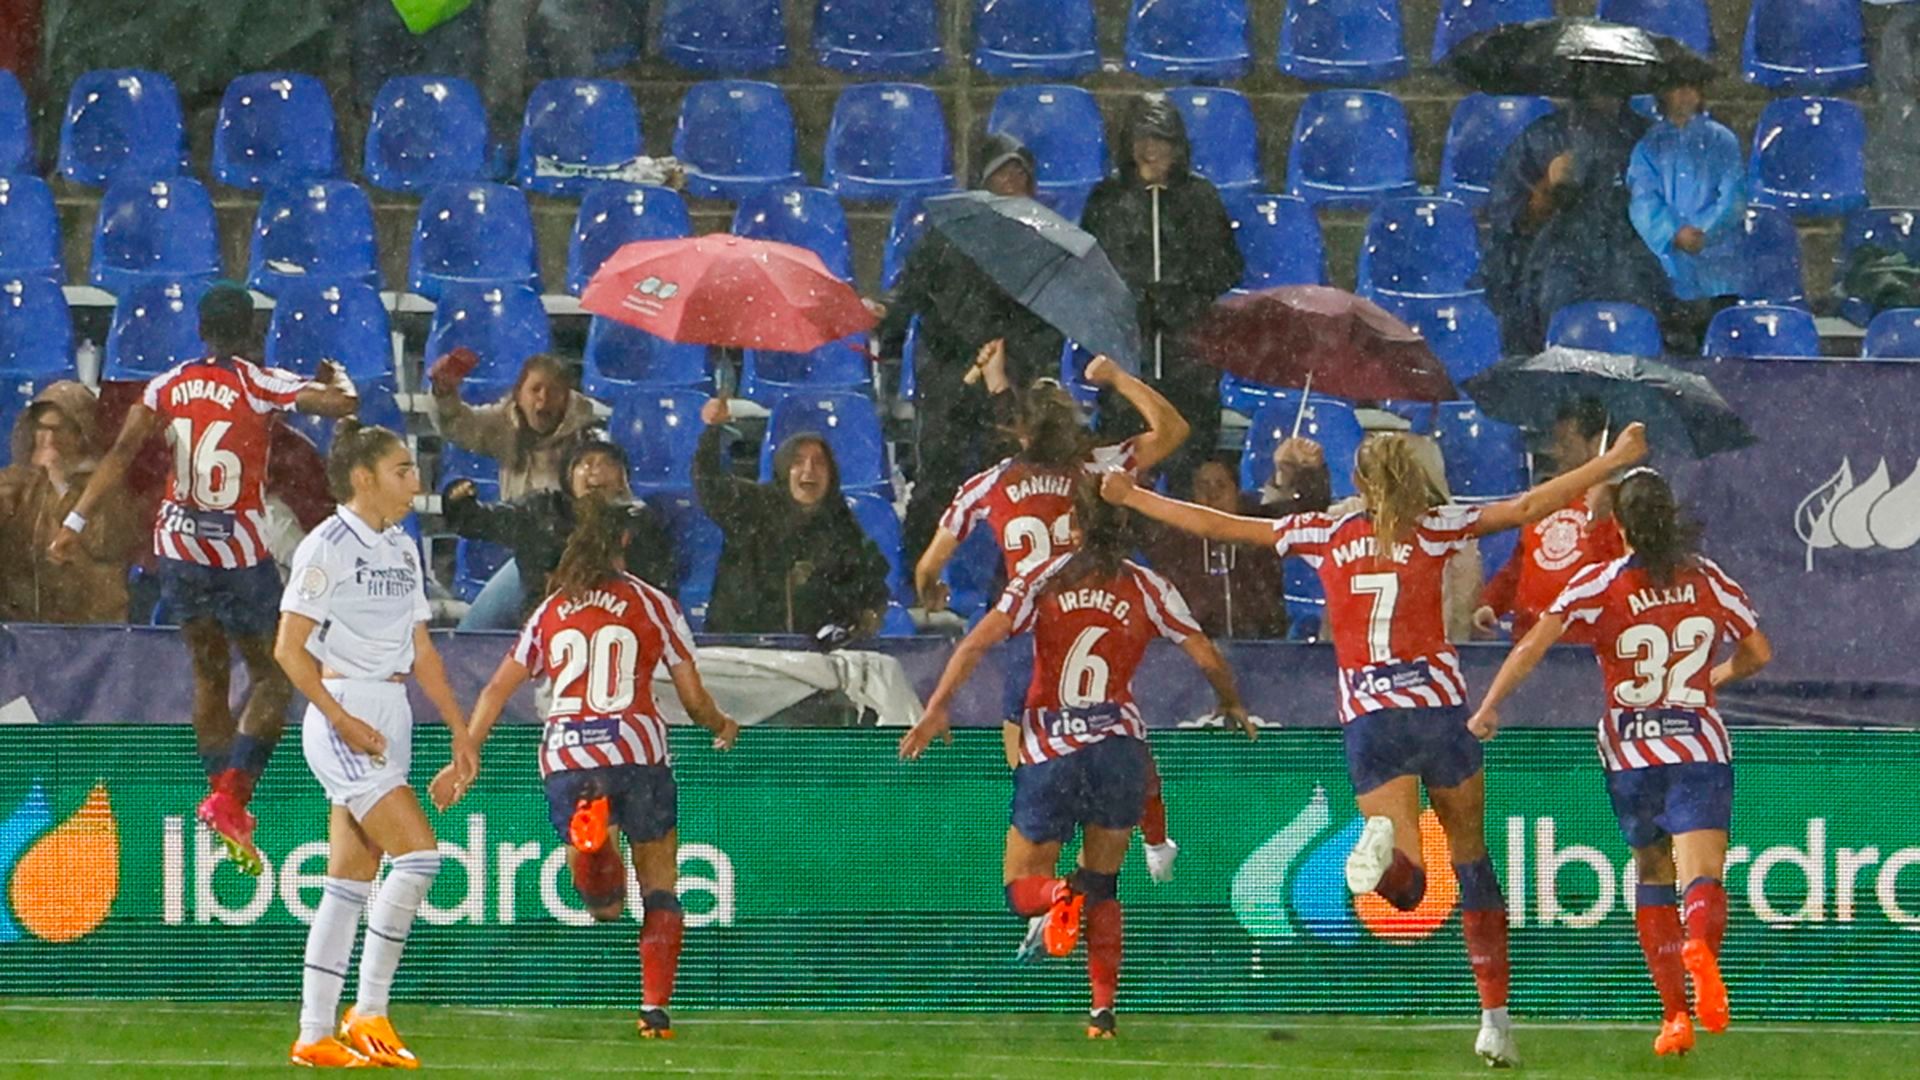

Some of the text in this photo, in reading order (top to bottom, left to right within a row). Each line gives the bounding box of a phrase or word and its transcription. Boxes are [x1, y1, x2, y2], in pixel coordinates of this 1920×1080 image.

[171, 379, 240, 411] AJIBADE
[165, 417, 242, 511] 16
[1332, 536, 1414, 568] MAITNE
[1058, 588, 1117, 614] IRENE
[1350, 572, 1399, 664] 7
[549, 624, 638, 715] 20
[1058, 625, 1110, 710] 6
[1614, 616, 1716, 708] 32
[1051, 711, 1088, 736] ria
[1624, 713, 1661, 740] ria
[163, 813, 736, 928] Ibedroa
